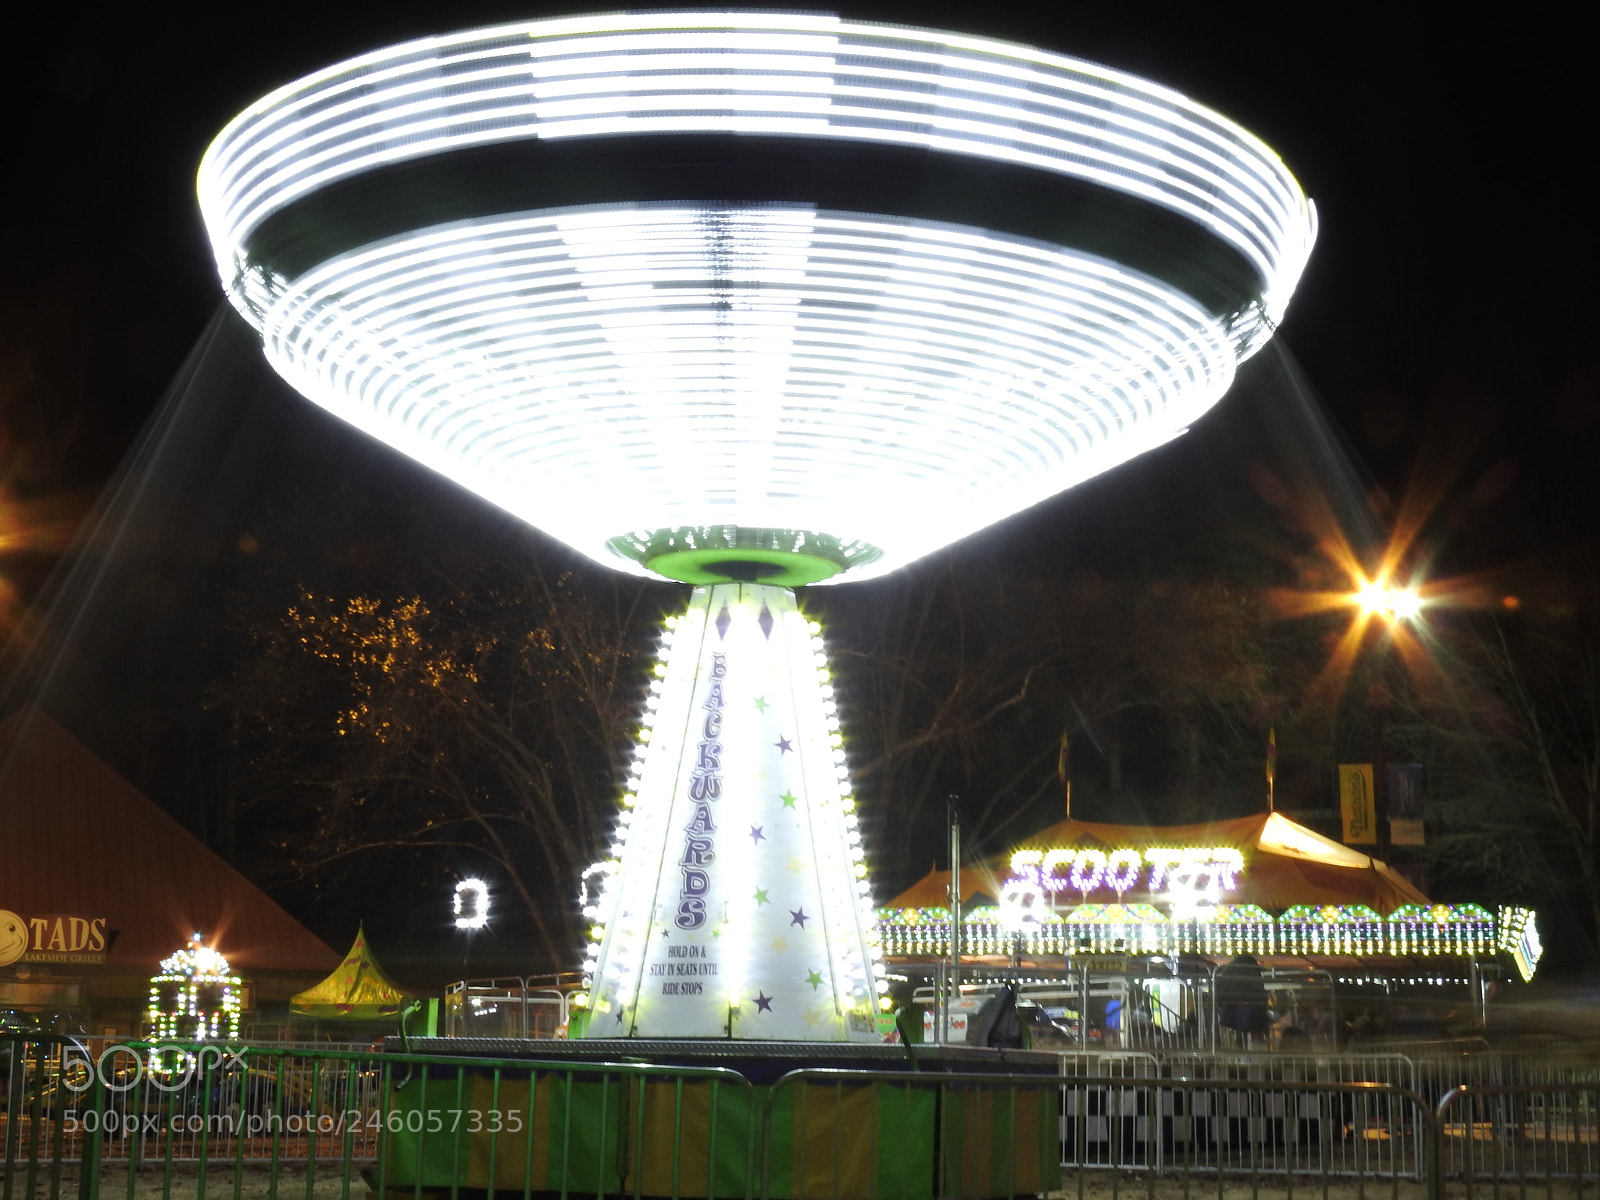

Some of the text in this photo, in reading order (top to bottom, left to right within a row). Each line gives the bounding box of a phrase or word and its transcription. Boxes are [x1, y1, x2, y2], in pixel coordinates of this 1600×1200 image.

[675, 651, 728, 930] BACKWARDS
[30, 917, 106, 952] TADS
[25, 953, 68, 963] LAKESIDE
[668, 945, 707, 958] HOLD ON &
[650, 963, 718, 976] STAY IN SEATS UNTIL
[662, 982, 703, 996] RIDE STOPS
